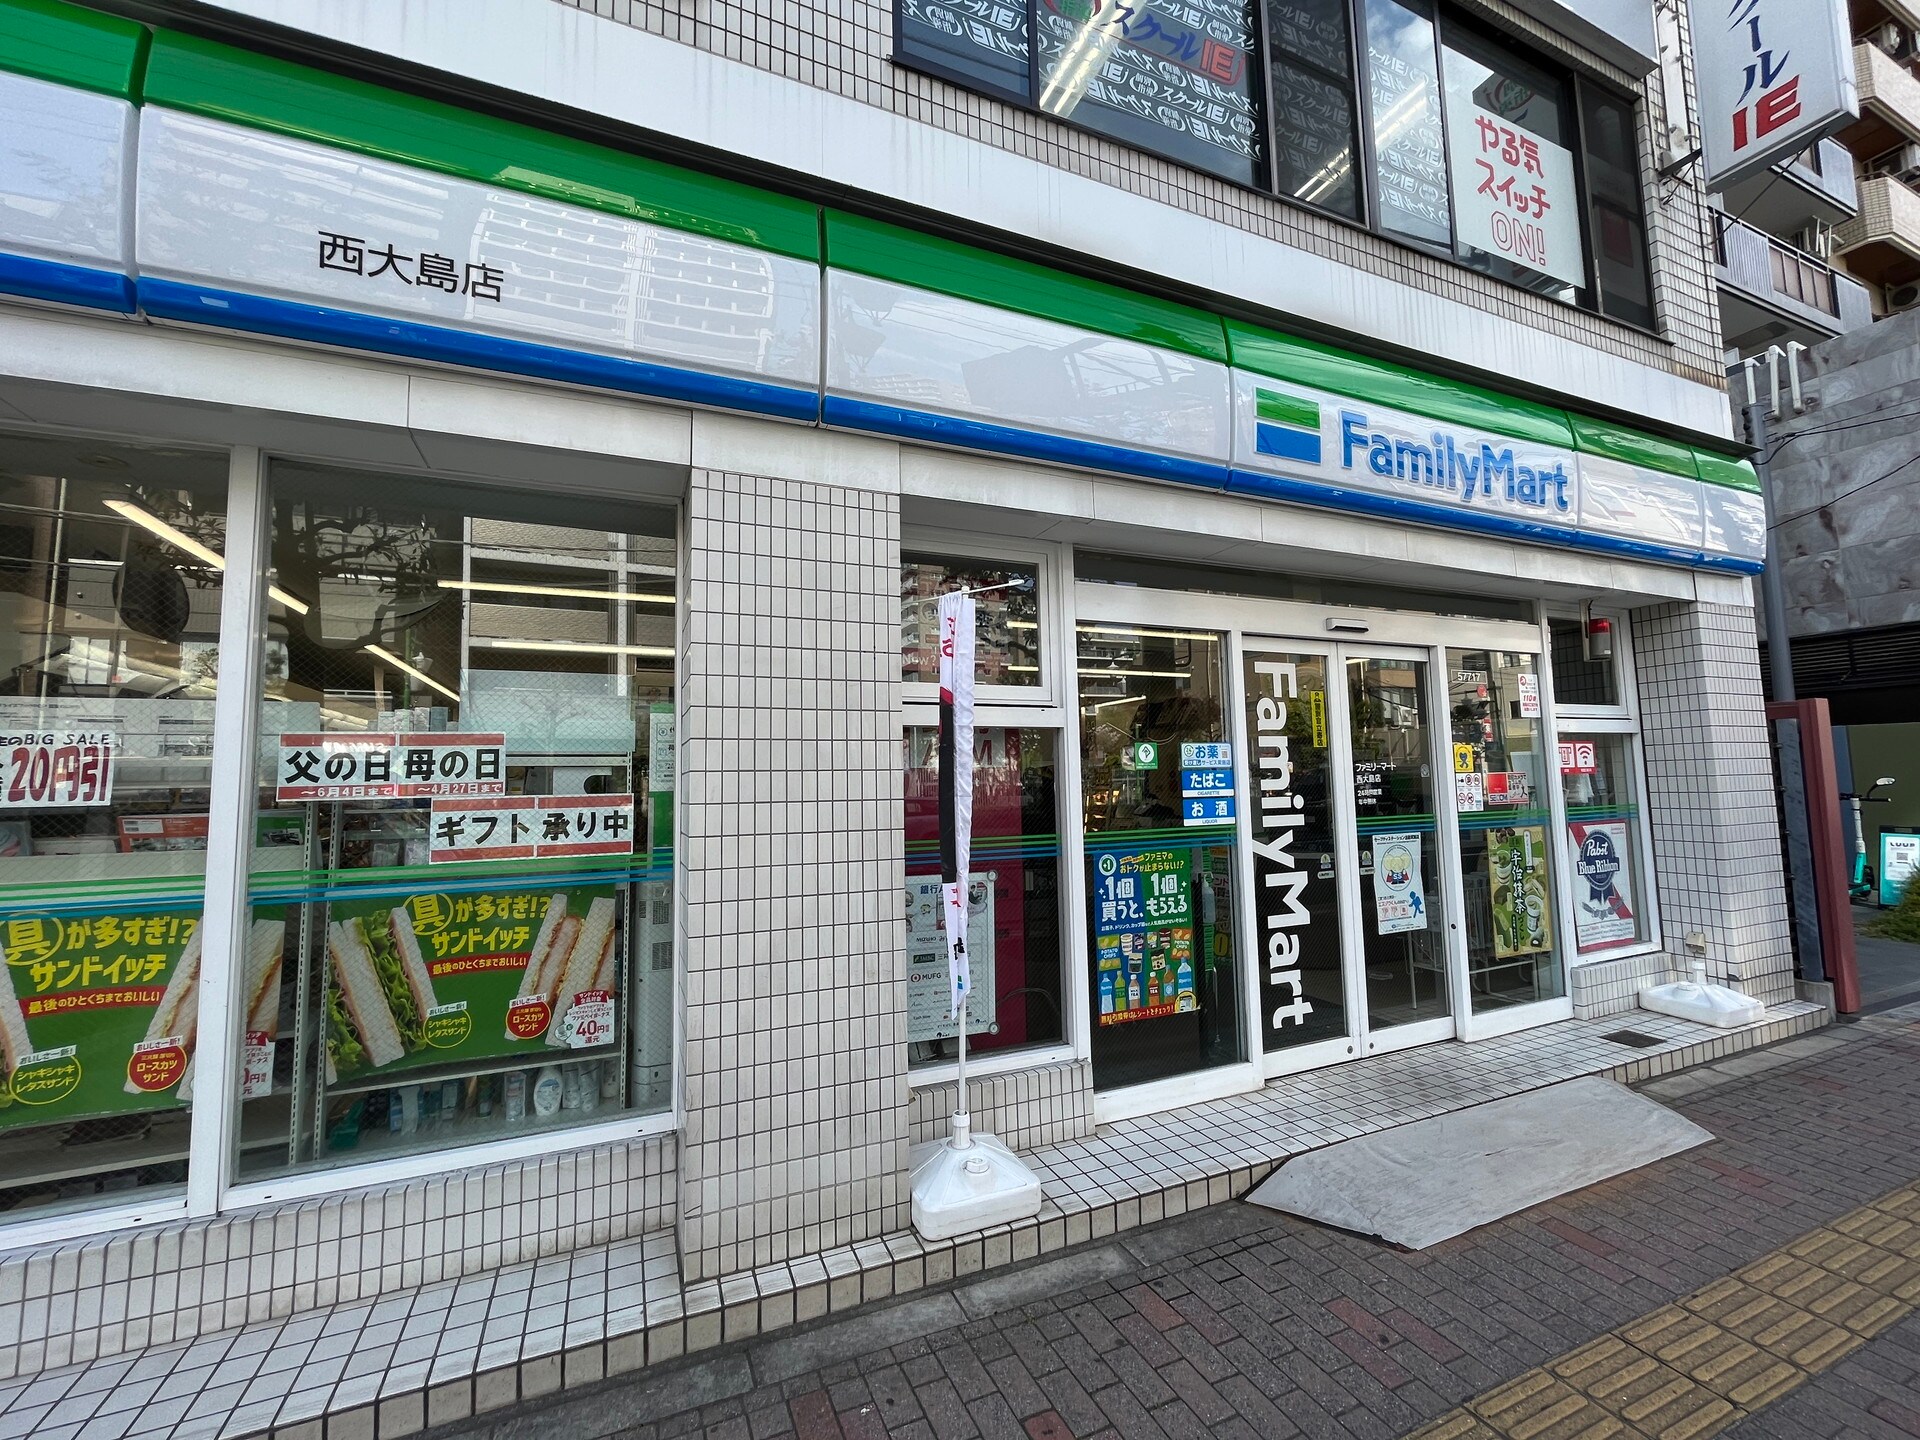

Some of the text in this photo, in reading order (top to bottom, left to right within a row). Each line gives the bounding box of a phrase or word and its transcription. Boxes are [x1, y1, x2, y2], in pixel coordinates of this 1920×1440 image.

[1157, 85, 1225, 122] スクールIE
[1475, 114, 1545, 179] やる気
[1475, 158, 1551, 219] スイッチ
[1491, 210, 1546, 267] ON!
[318, 230, 504, 303] 西大島店
[1338, 408, 1569, 512] FamilyMart
[63, 733, 110, 746] SALE
[1195, 745, 1219, 759] お薬
[8, 745, 111, 803] 20円引
[284, 750, 391, 784] 父の日
[403, 748, 500, 782] 母の日
[1355, 762, 1397, 772] ファミリーマート
[1190, 773, 1226, 788] たばこ
[1356, 774, 1382, 784] 西大島店
[1252, 661, 1314, 1030] FamilyMart
[1586, 839, 1609, 857] Pabst
[1578, 860, 1619, 875] Blue Ribbon
[1105, 876, 1135, 900] 1個
[1150, 873, 1178, 896] 1個
[1511, 848, 1527, 914] 宇治抹茶
[1146, 894, 1188, 917] もらえる
[431, 926, 530, 958] サンドイッチ
[30, 953, 167, 992] サンドイッチ
[432, 957, 527, 975] 最後のひとくちまでおいしい
[28, 991, 160, 1014] 最後のひとくちまでおいしい
[512, 1013, 544, 1024] ロースカツ
[518, 1022, 539, 1032] サンド
[17, 1065, 76, 1081] シャキシャキ
[136, 1060, 178, 1072] ロースカツ
[143, 1072, 169, 1083] サンド
